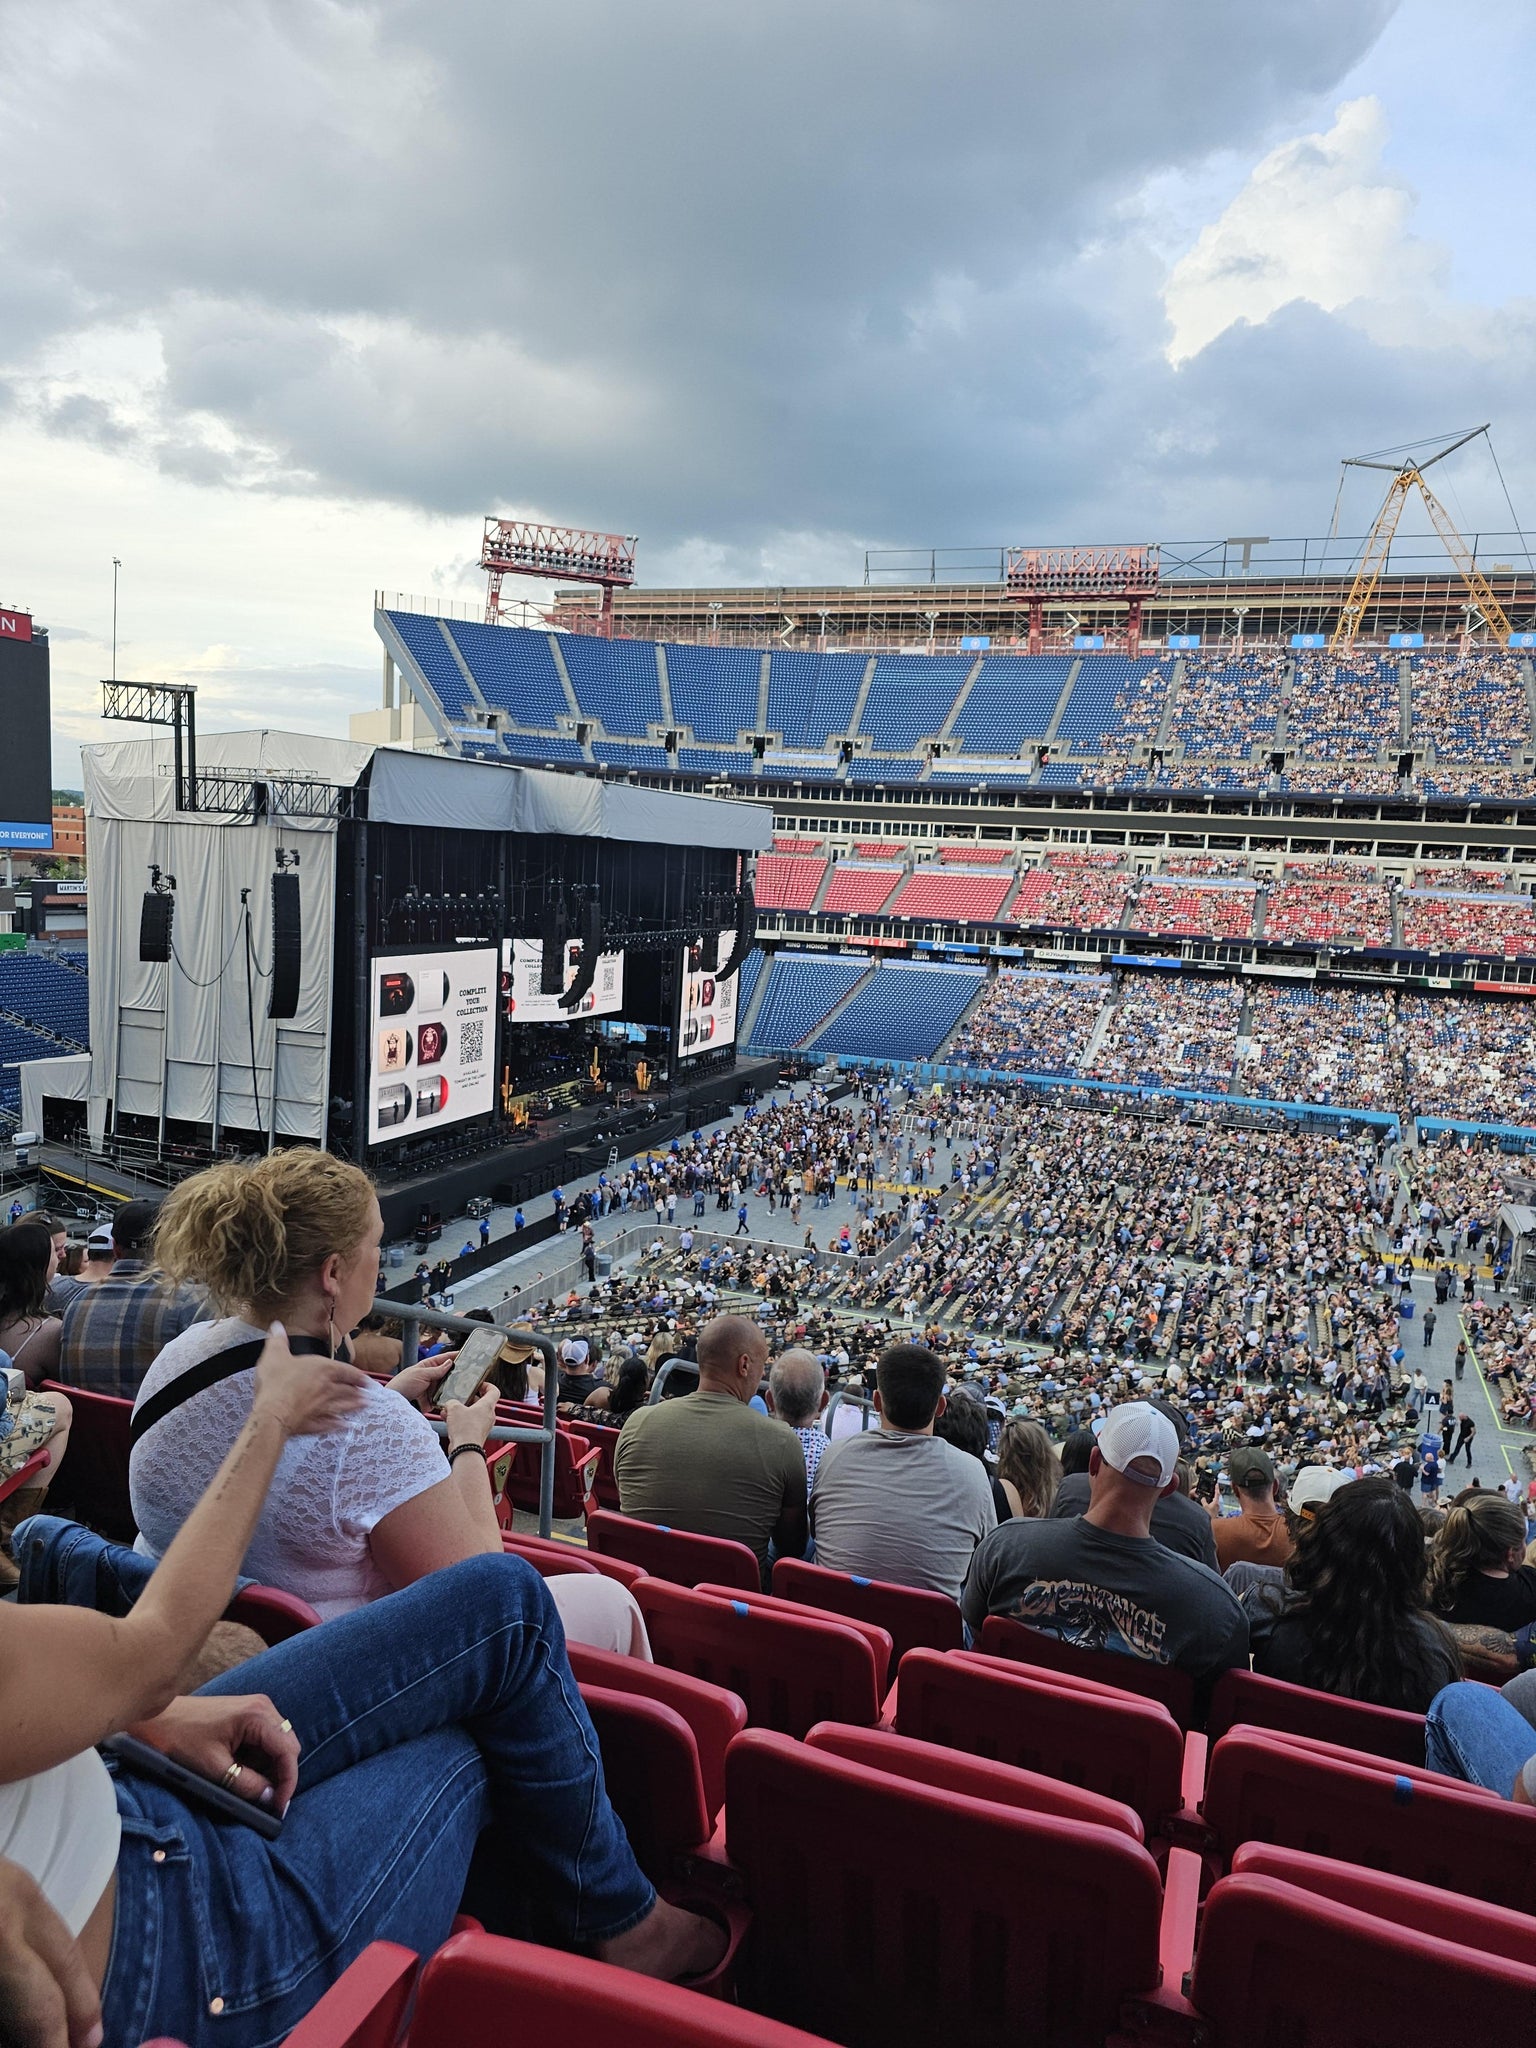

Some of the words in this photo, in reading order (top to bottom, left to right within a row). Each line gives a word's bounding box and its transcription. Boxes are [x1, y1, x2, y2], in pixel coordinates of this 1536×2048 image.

[459, 987, 487, 996] COMPLETE
[466, 997, 480, 1005] YOUR
[456, 1005, 488, 1016] COLLECTION
[1428, 1395, 1436, 1404] A
[1096, 1589, 1170, 1665] RANGE
